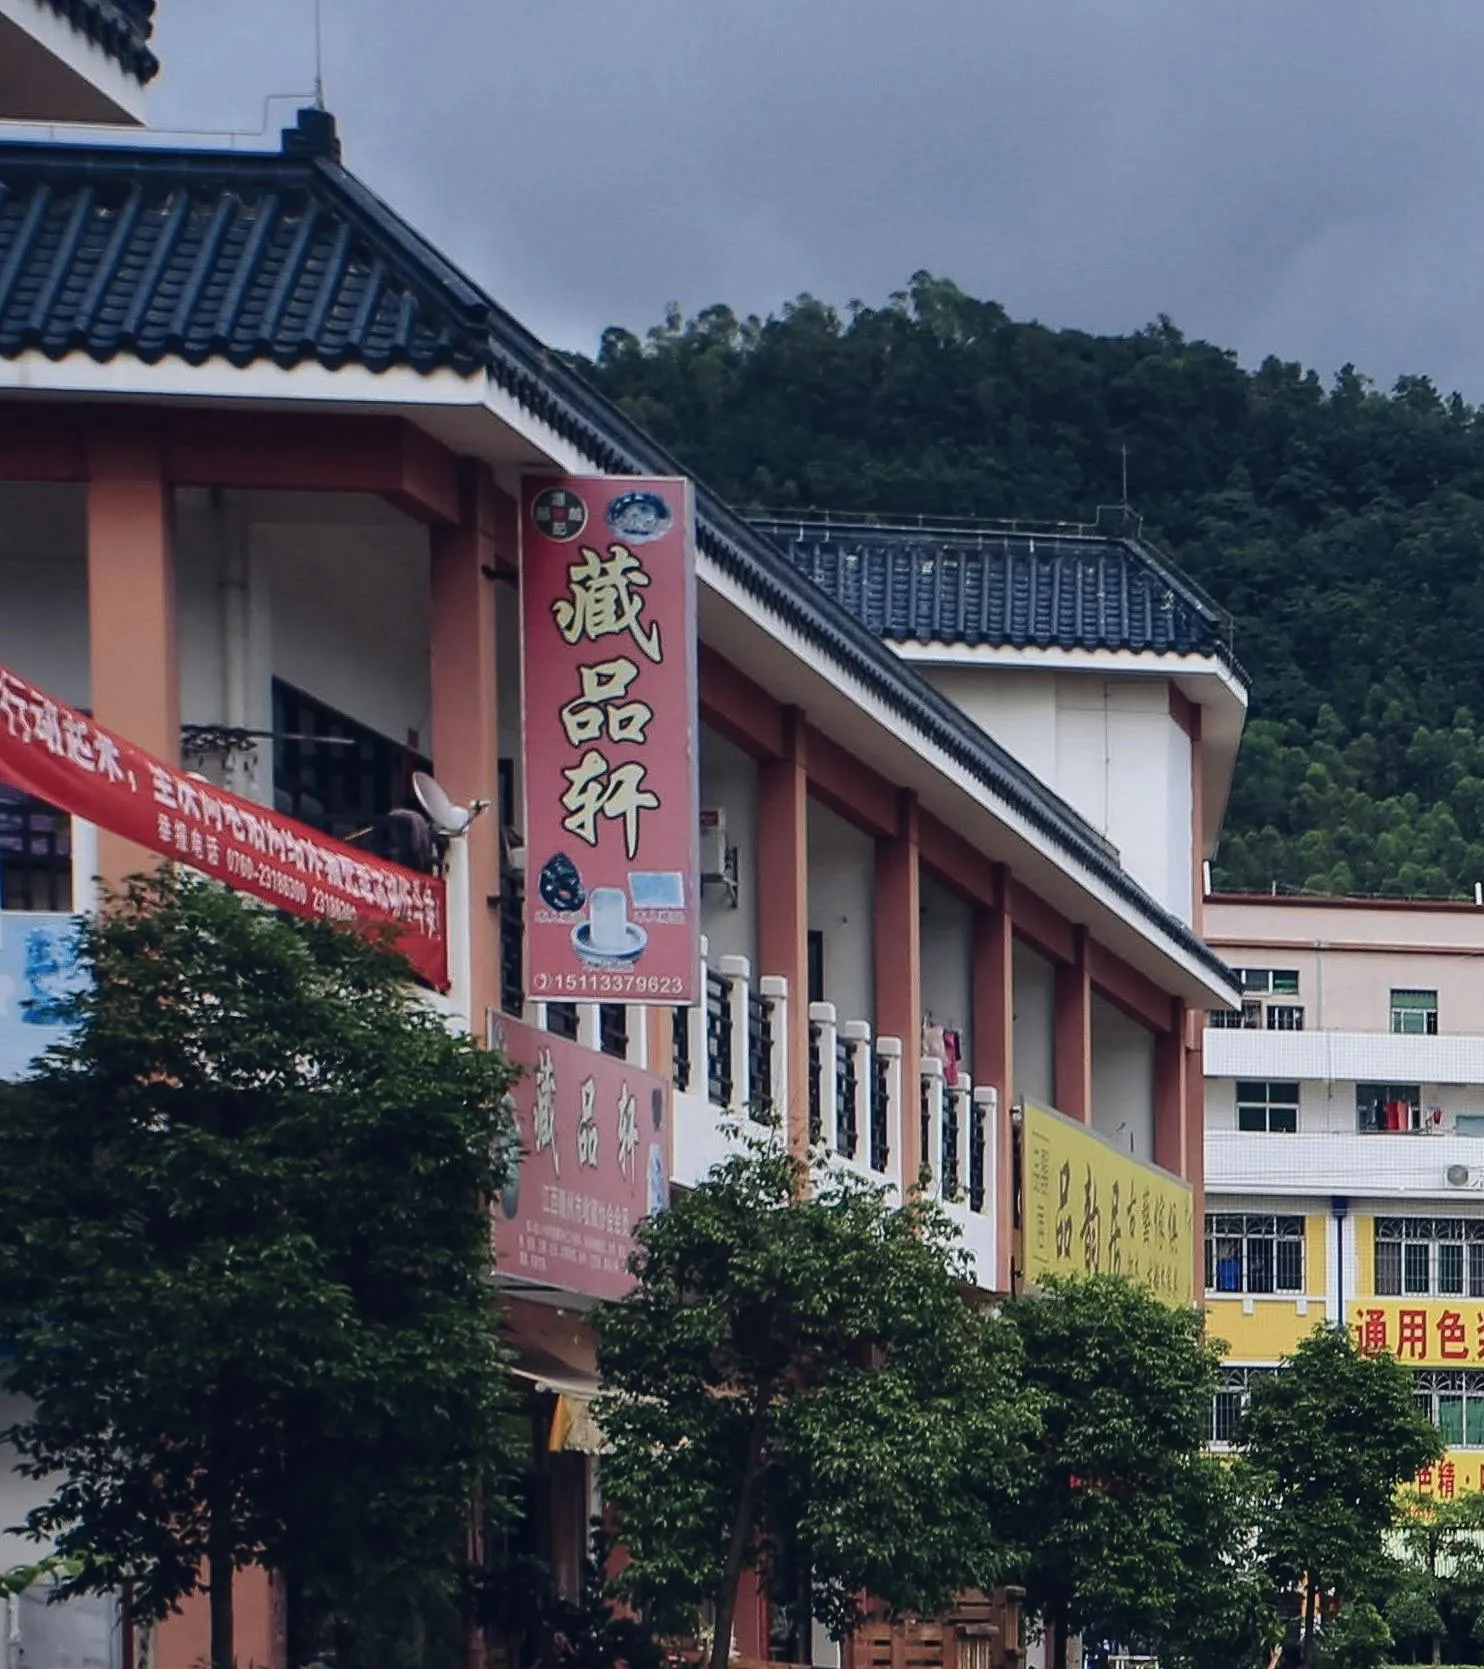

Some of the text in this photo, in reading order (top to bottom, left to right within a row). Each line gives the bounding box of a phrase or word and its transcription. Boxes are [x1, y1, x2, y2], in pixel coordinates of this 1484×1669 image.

[549, 543, 664, 860] 藏品轩
[555, 974, 684, 994] 15113379623
[532, 1046, 640, 1197] 藏品轩
